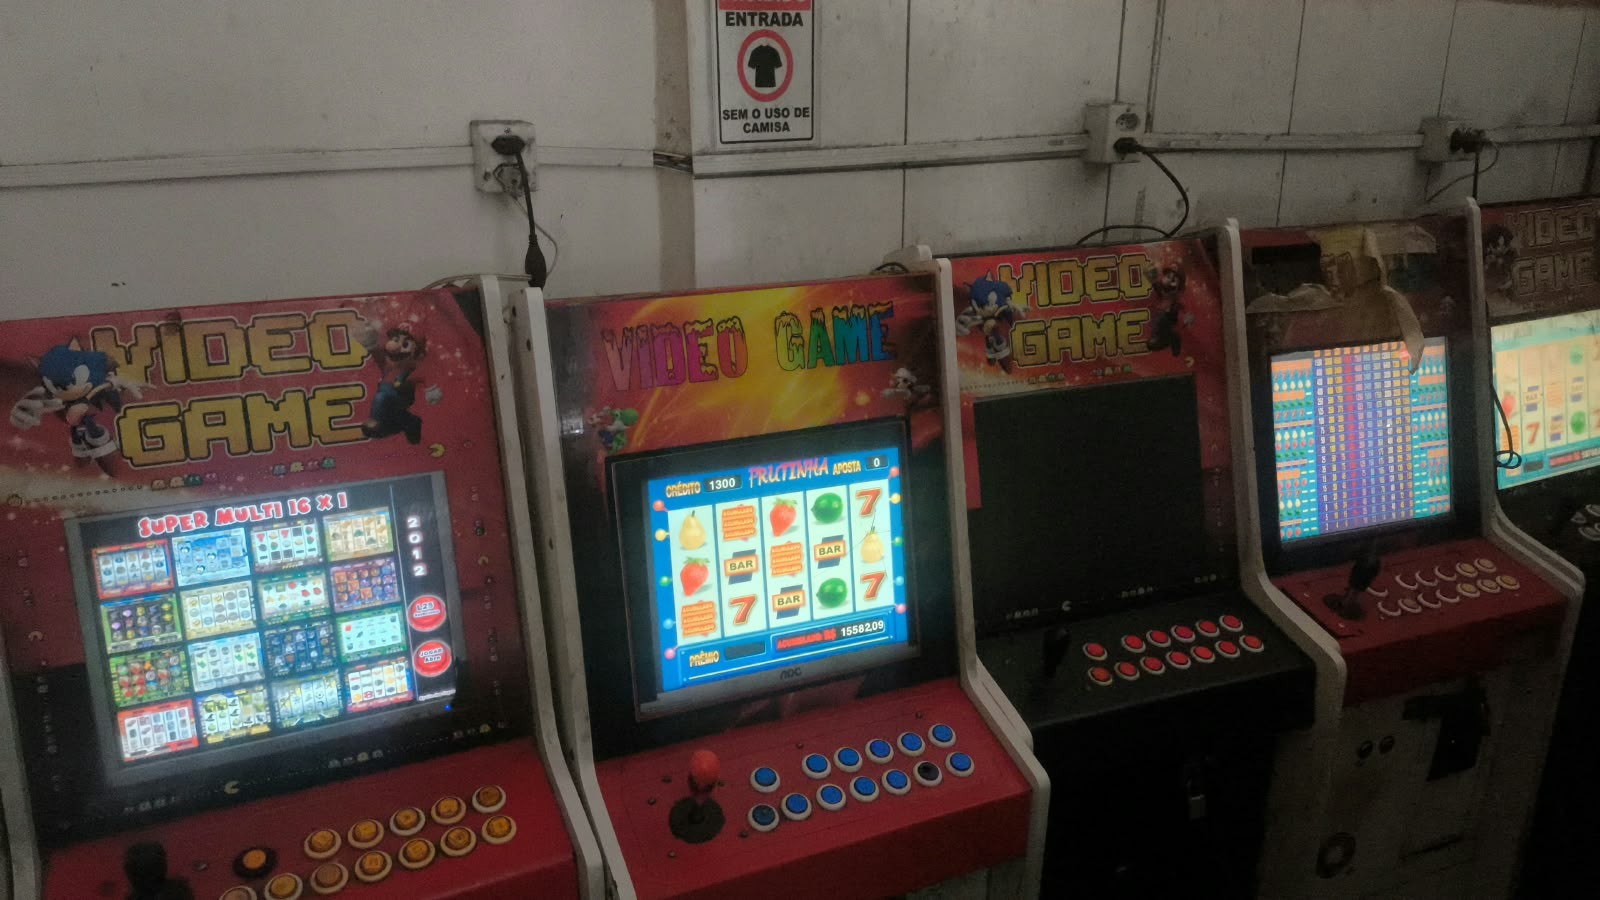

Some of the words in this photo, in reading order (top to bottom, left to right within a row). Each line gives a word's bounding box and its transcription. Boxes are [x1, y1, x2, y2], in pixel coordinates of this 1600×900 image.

[725, 12, 803, 27] ENTRADA
[723, 109, 748, 120] SEM
[752, 108, 761, 119] O
[765, 107, 790, 119] USO
[794, 107, 810, 118] DE
[743, 121, 790, 133] CAMISA
[997, 253, 1154, 308] VIDEO
[90, 309, 372, 385] VIDEO
[600, 316, 749, 392] VIDEO
[774, 300, 898, 372] GAME
[1009, 309, 1152, 368] GAME
[115, 381, 370, 468] GAME
[665, 481, 701, 498] CRÉDITO
[709, 478, 736, 490] 1300
[833, 460, 861, 475] APOSTA
[873, 457, 880, 467] 0
[138, 510, 209, 538] SUPER
[214, 501, 283, 526] MULTI
[316, 493, 333, 512] X
[856, 487, 882, 518] 7
[407, 515, 427, 577] 2012
[819, 545, 842, 556] BAR
[729, 560, 754, 571] BAR
[777, 595, 801, 606] BAR
[861, 572, 887, 602] 7
[729, 594, 757, 625] 7
[841, 620, 884, 637] 15582,09
